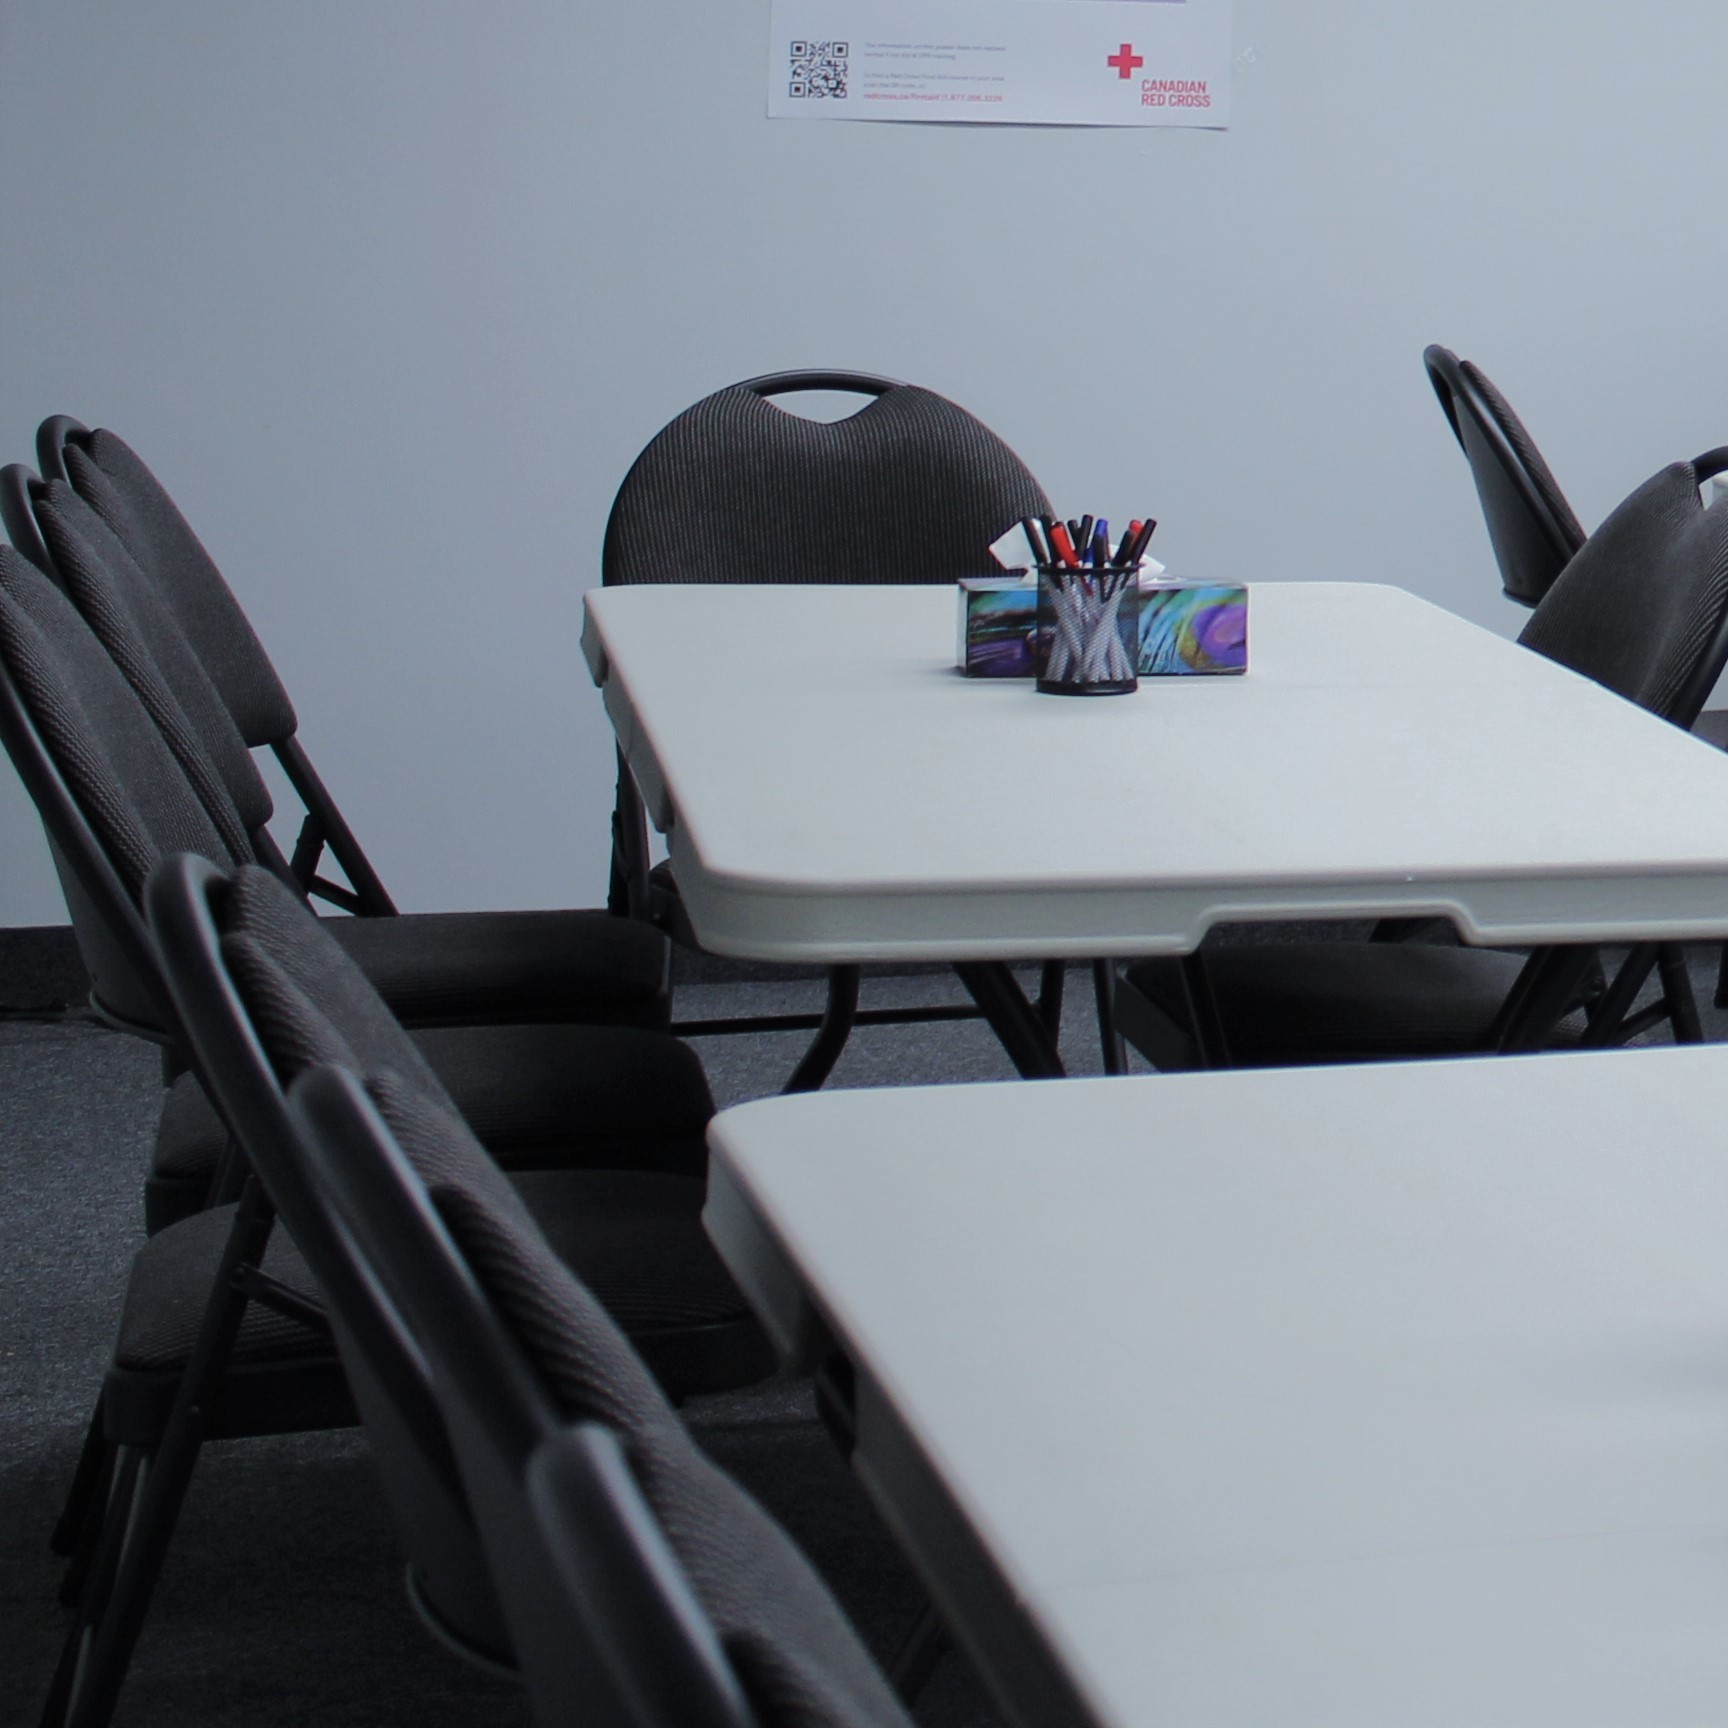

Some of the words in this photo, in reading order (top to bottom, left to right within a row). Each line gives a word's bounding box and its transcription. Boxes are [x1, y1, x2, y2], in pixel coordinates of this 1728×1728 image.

[1141, 78, 1207, 93] CANADIAN
[1141, 92, 1166, 107] RED
[1169, 93, 1211, 108] CROSS
